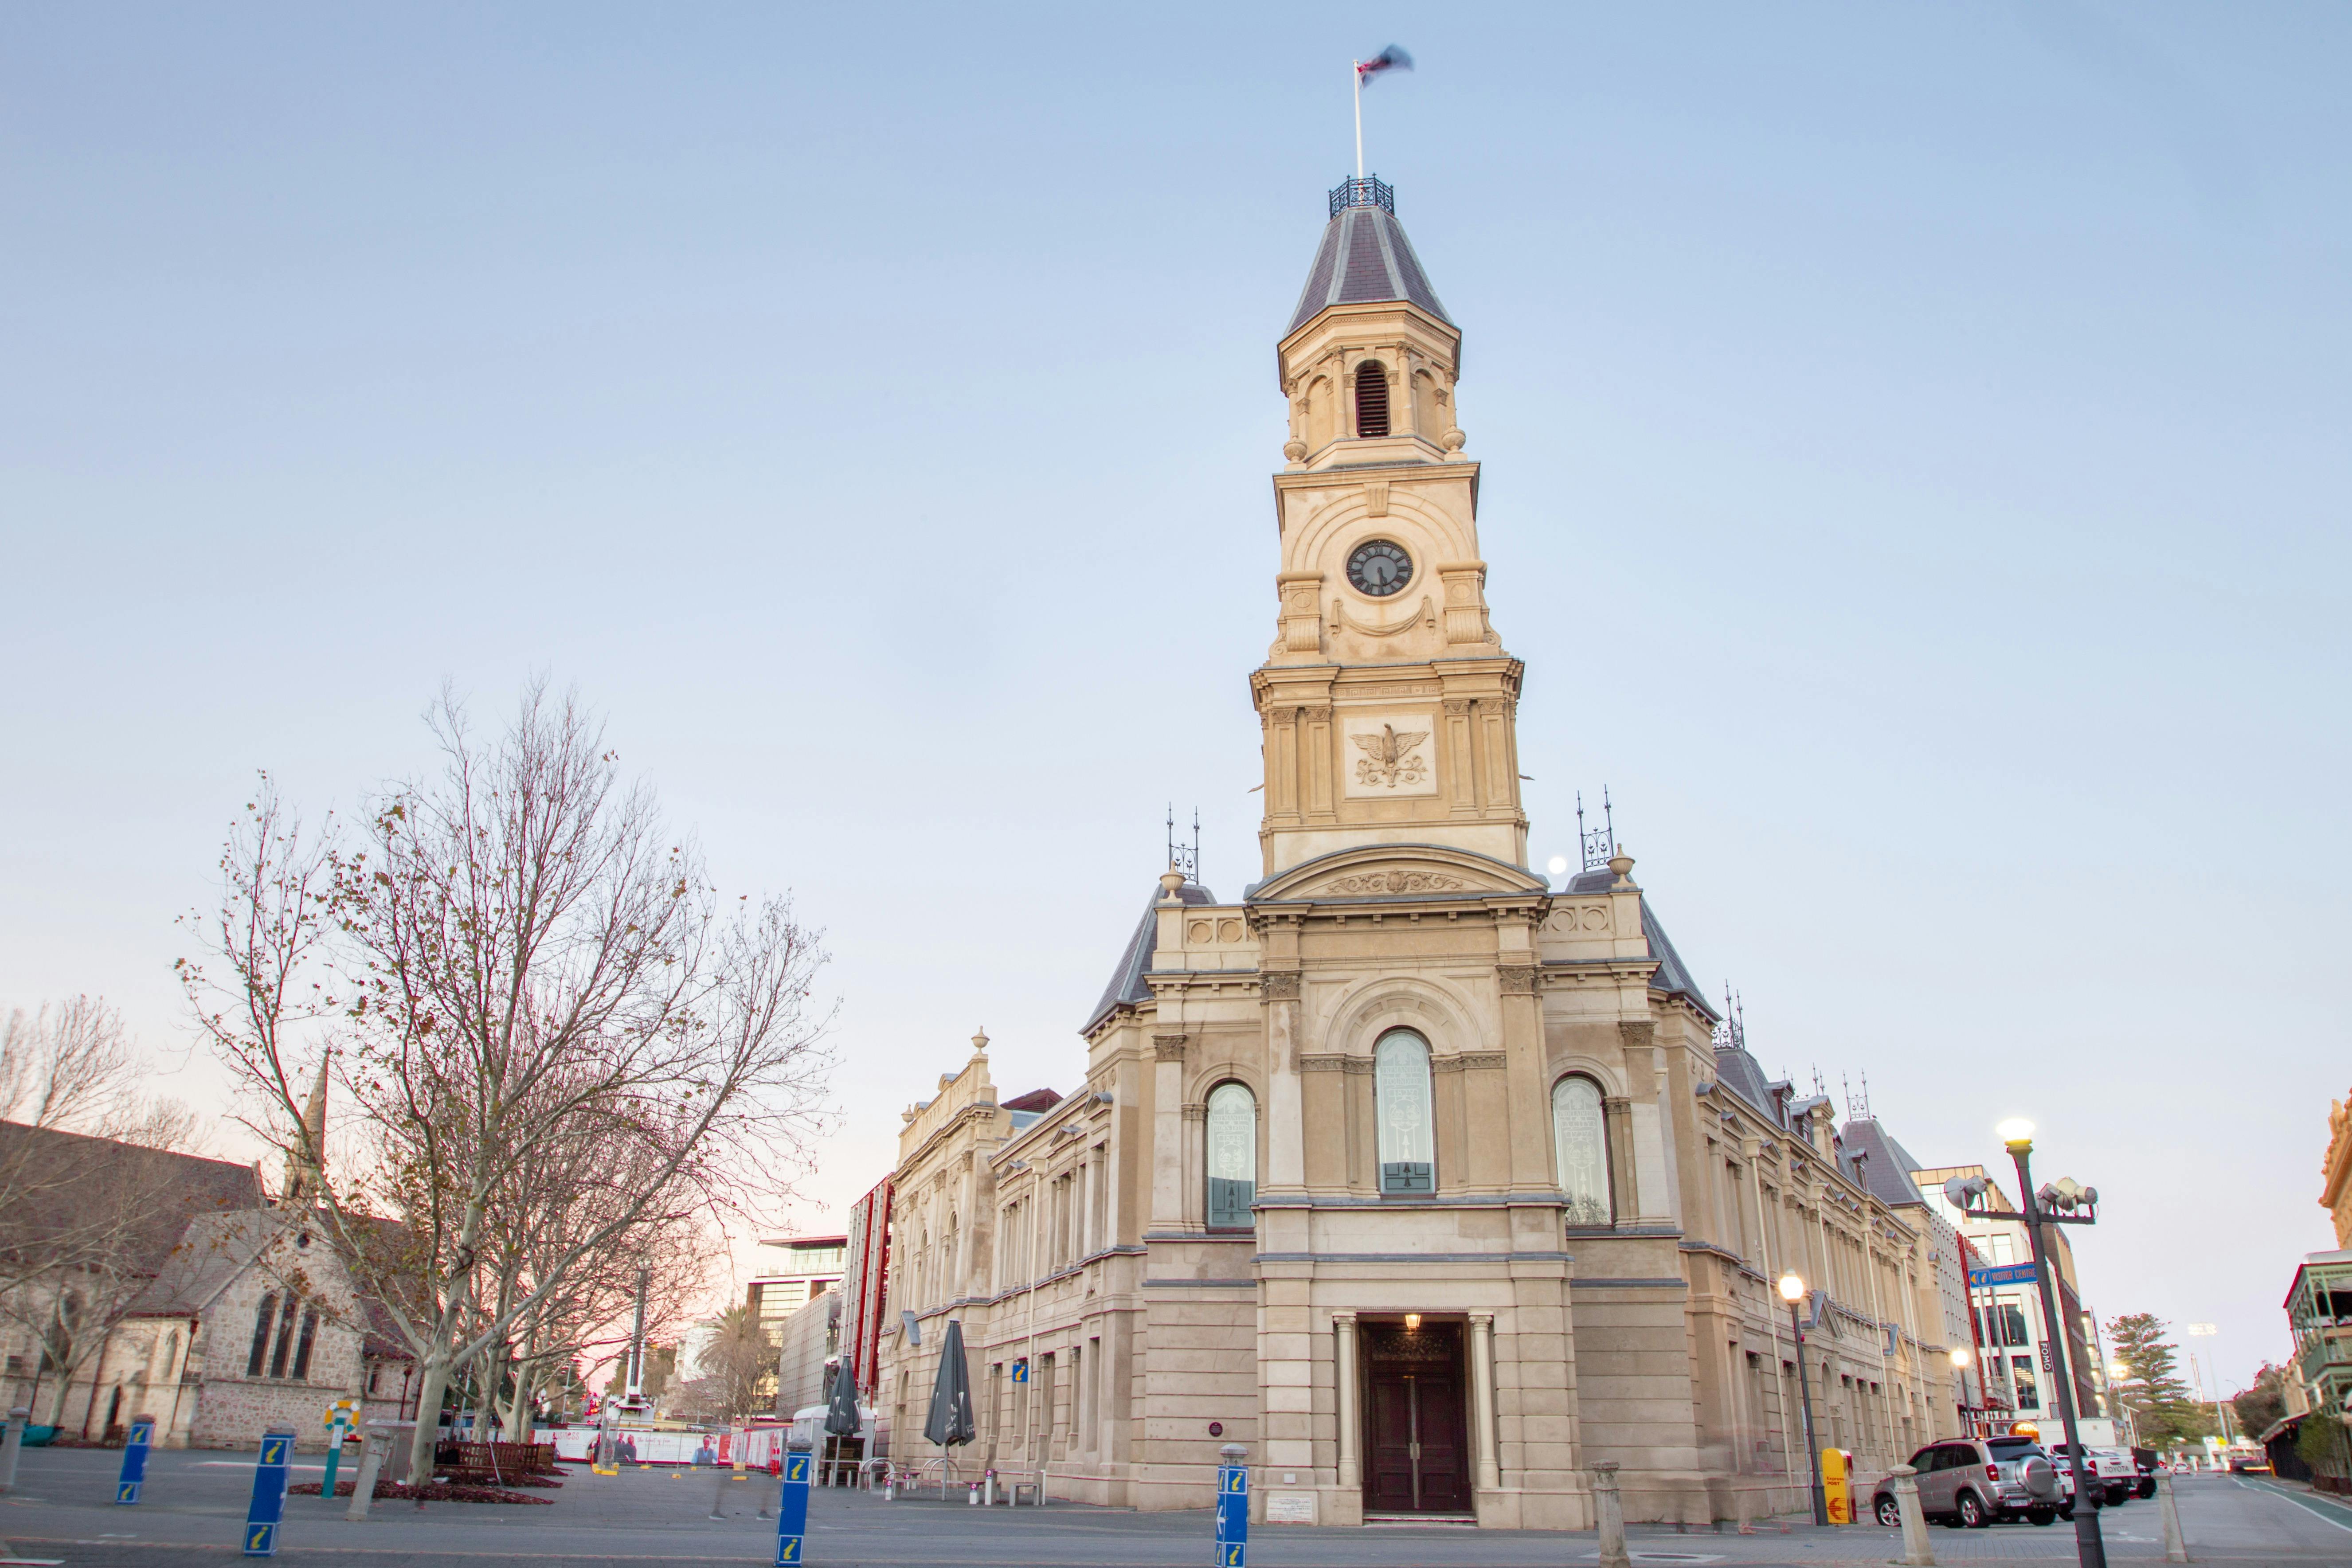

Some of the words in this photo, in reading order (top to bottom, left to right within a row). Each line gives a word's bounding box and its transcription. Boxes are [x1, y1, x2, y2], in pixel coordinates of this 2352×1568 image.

[1992, 1270, 2013, 1282] VISITOR
[2014, 1267, 2037, 1279] CENTRE
[2040, 1343, 2051, 1370] FOMO
